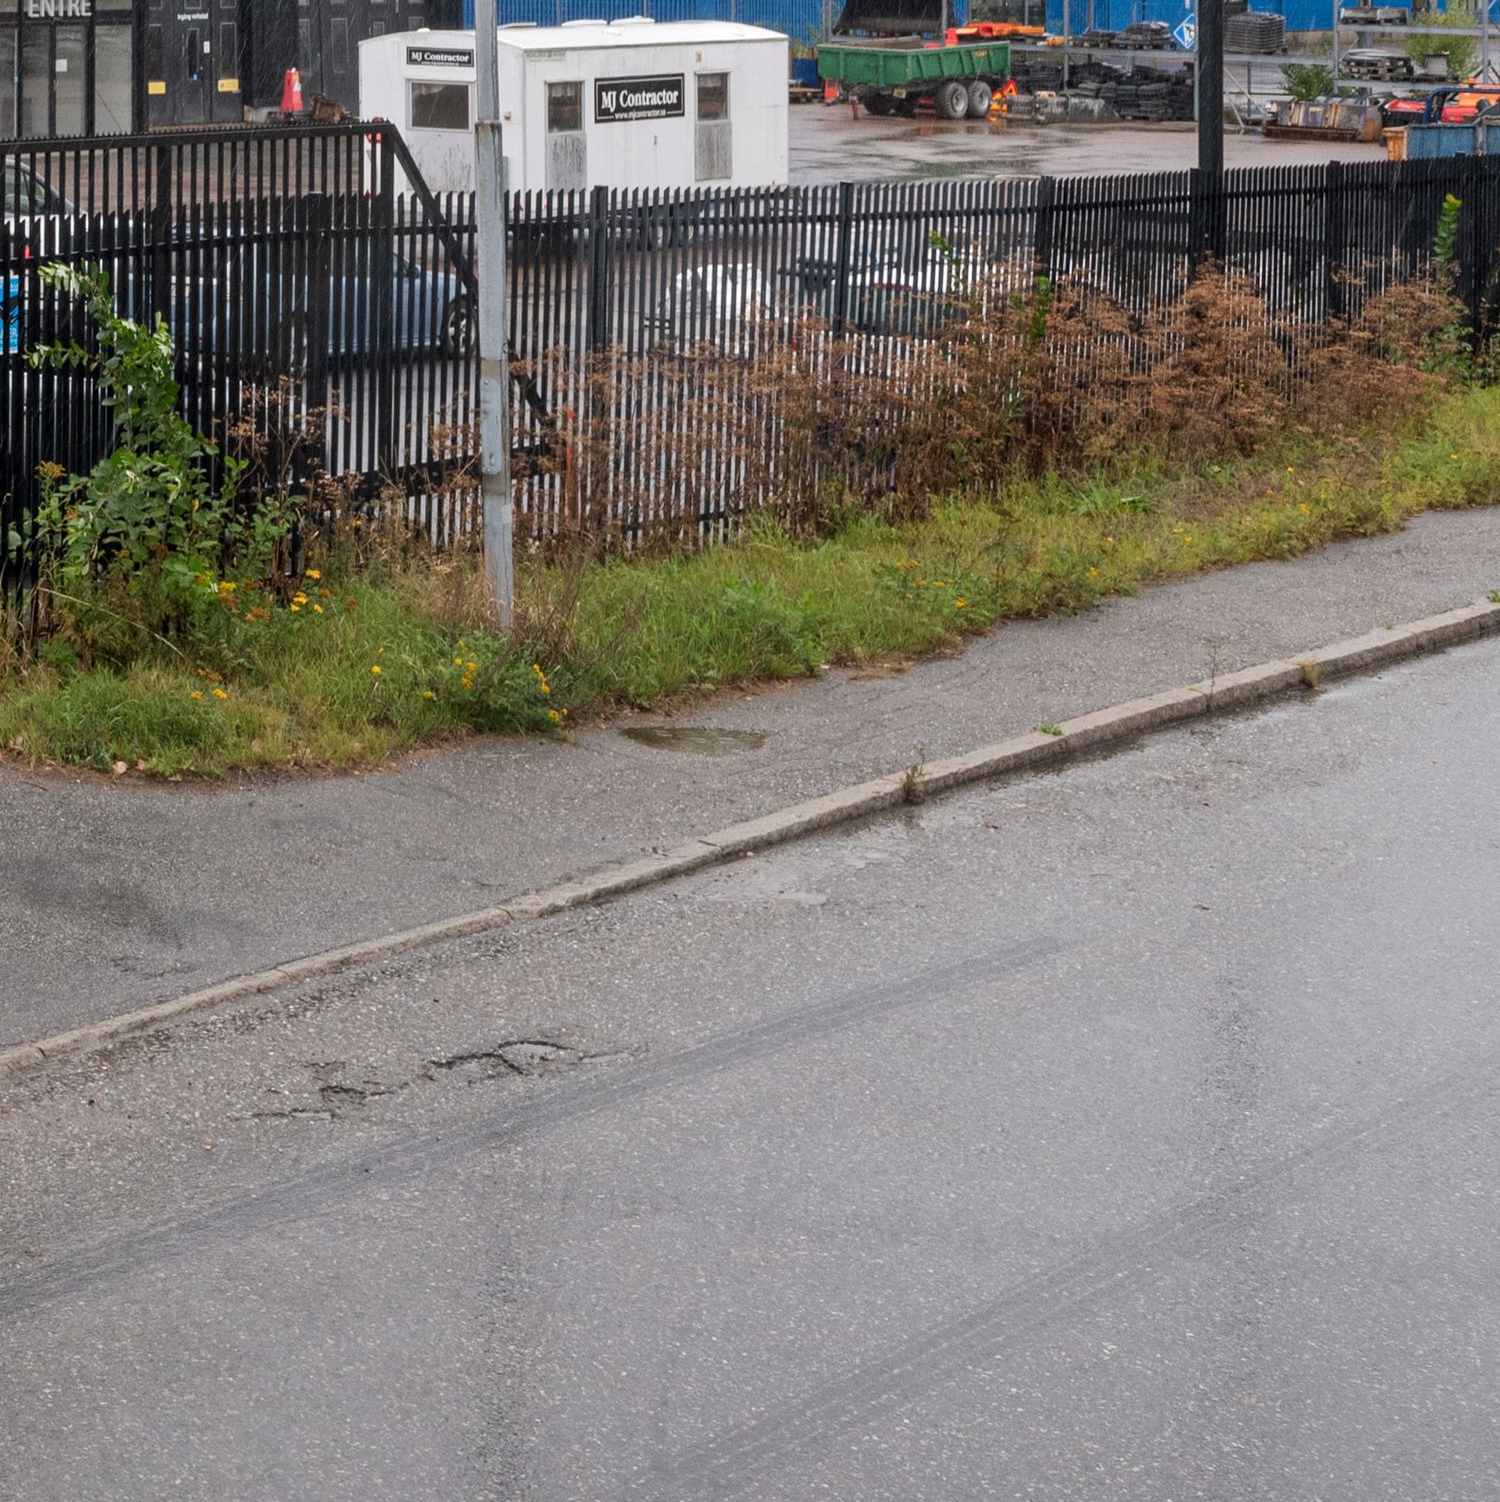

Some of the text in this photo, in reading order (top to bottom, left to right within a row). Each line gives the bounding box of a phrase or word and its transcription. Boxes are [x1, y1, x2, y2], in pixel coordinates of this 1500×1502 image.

[411, 51, 470, 63] MJ Contractor
[601, 89, 679, 113] MJ Contractor
